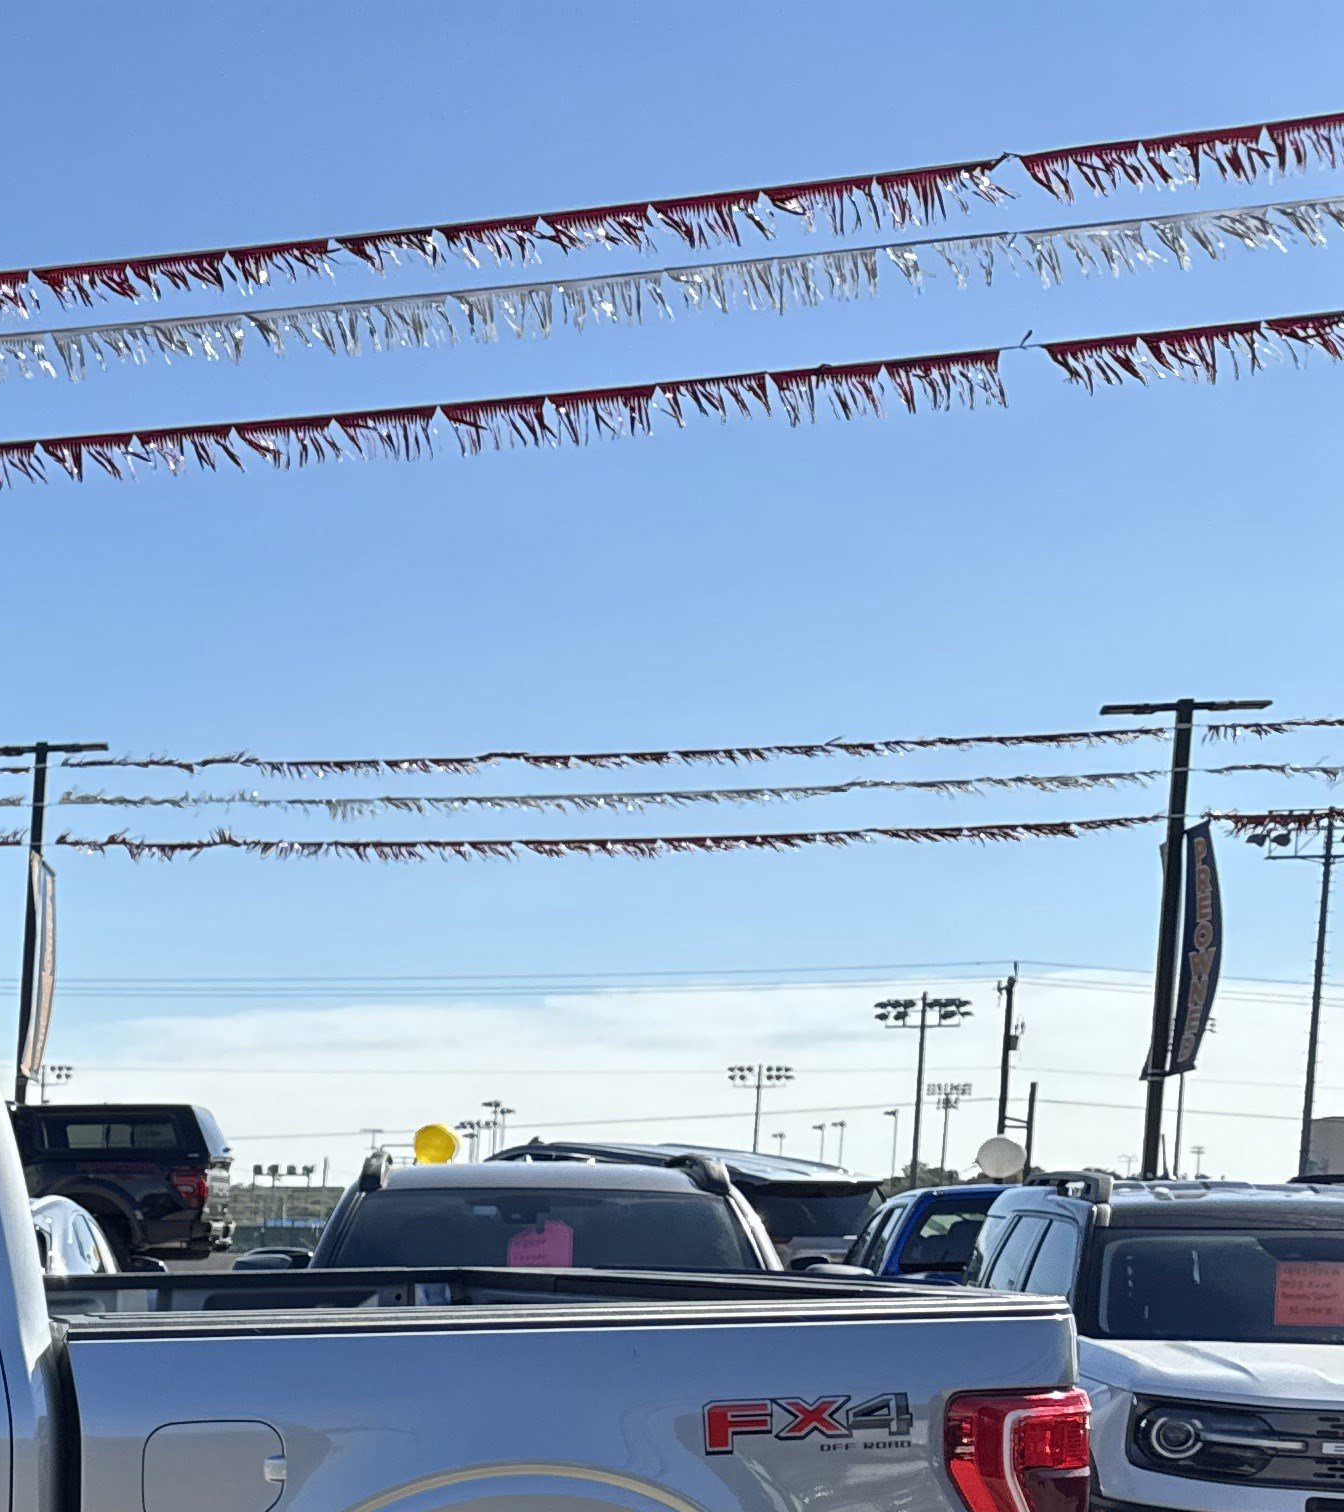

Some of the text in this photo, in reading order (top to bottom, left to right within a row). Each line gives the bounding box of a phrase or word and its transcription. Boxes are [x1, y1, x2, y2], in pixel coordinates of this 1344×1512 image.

[703, 1392, 913, 1456] FX4
[820, 1440, 912, 1452] OFF ROAD
